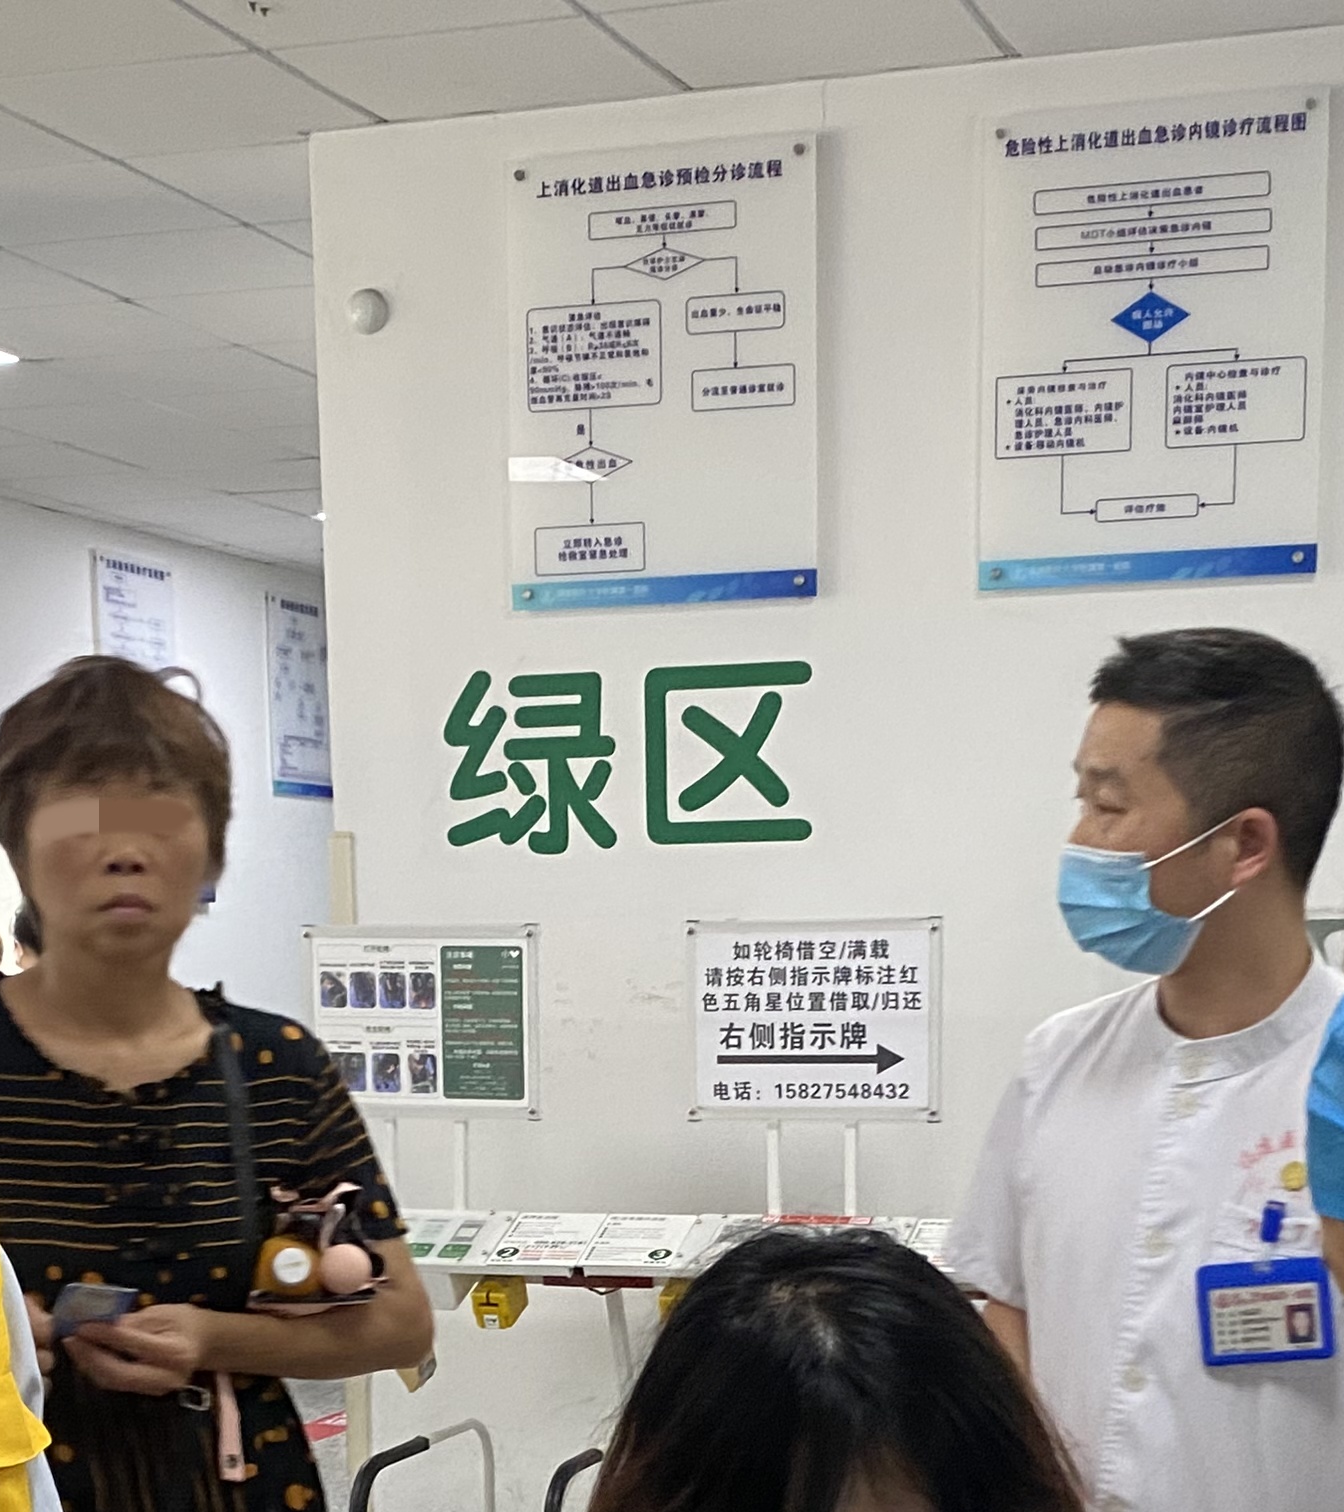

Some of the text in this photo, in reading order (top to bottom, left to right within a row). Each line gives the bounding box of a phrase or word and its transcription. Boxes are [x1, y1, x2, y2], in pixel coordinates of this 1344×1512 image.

[1005, 112, 1307, 157] 危险性上消化道出血急诊内镜诊疗流程图
[536, 159, 783, 199] 上消化道出血急诊预检分诊流程
[444, 660, 812, 853] 绿区
[733, 939, 889, 961] 如轮椅借空/满载
[705, 965, 919, 987] 请按右侧指示牌标注红
[702, 991, 923, 1012] 色五角星位置借取/归还
[720, 1021, 868, 1050] 右侧指示牌
[713, 1081, 910, 1101] 电话： 15827548432
